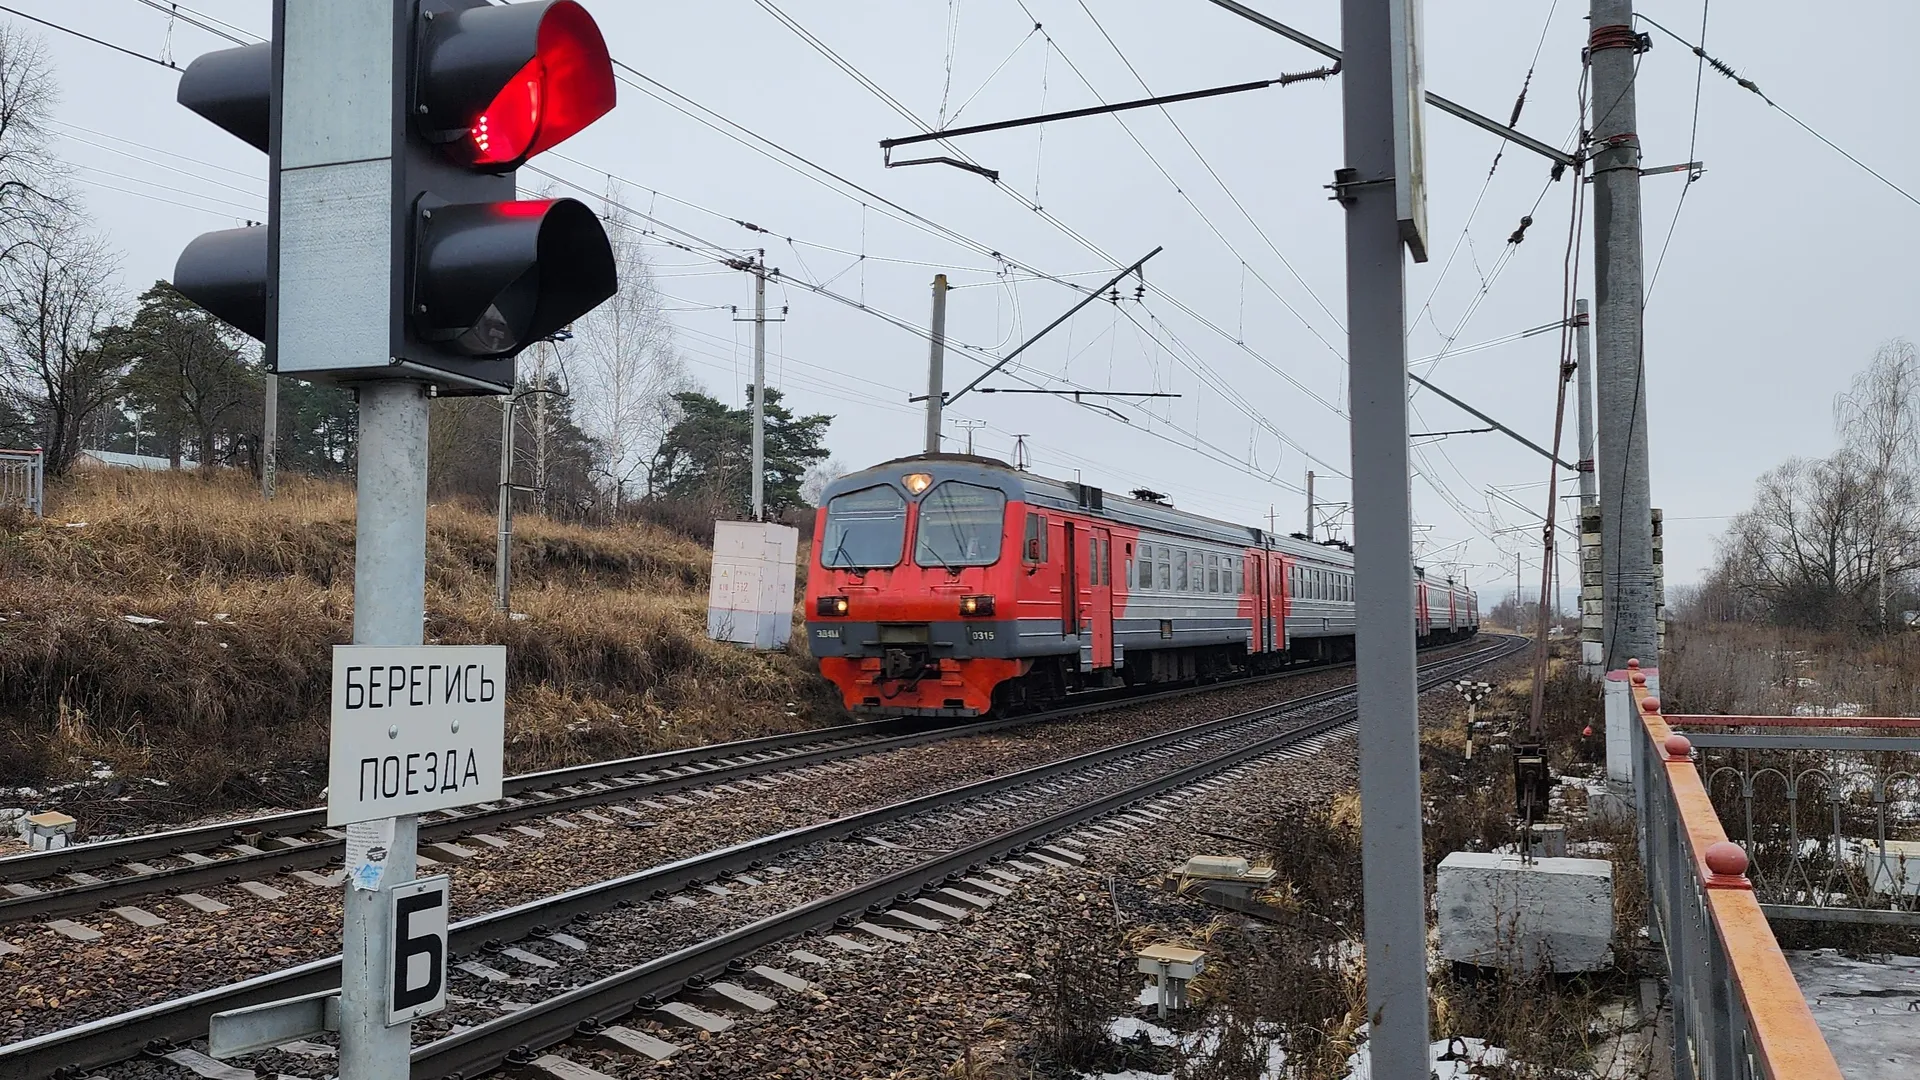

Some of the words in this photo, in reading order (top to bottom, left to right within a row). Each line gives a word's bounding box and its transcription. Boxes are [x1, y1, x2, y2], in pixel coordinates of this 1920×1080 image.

[972, 631, 995, 640] 0315
[345, 664, 496, 710] БЕРЕГИСЬ
[359, 747, 480, 802] ПОЕЗДА
[394, 889, 444, 1012] Б
